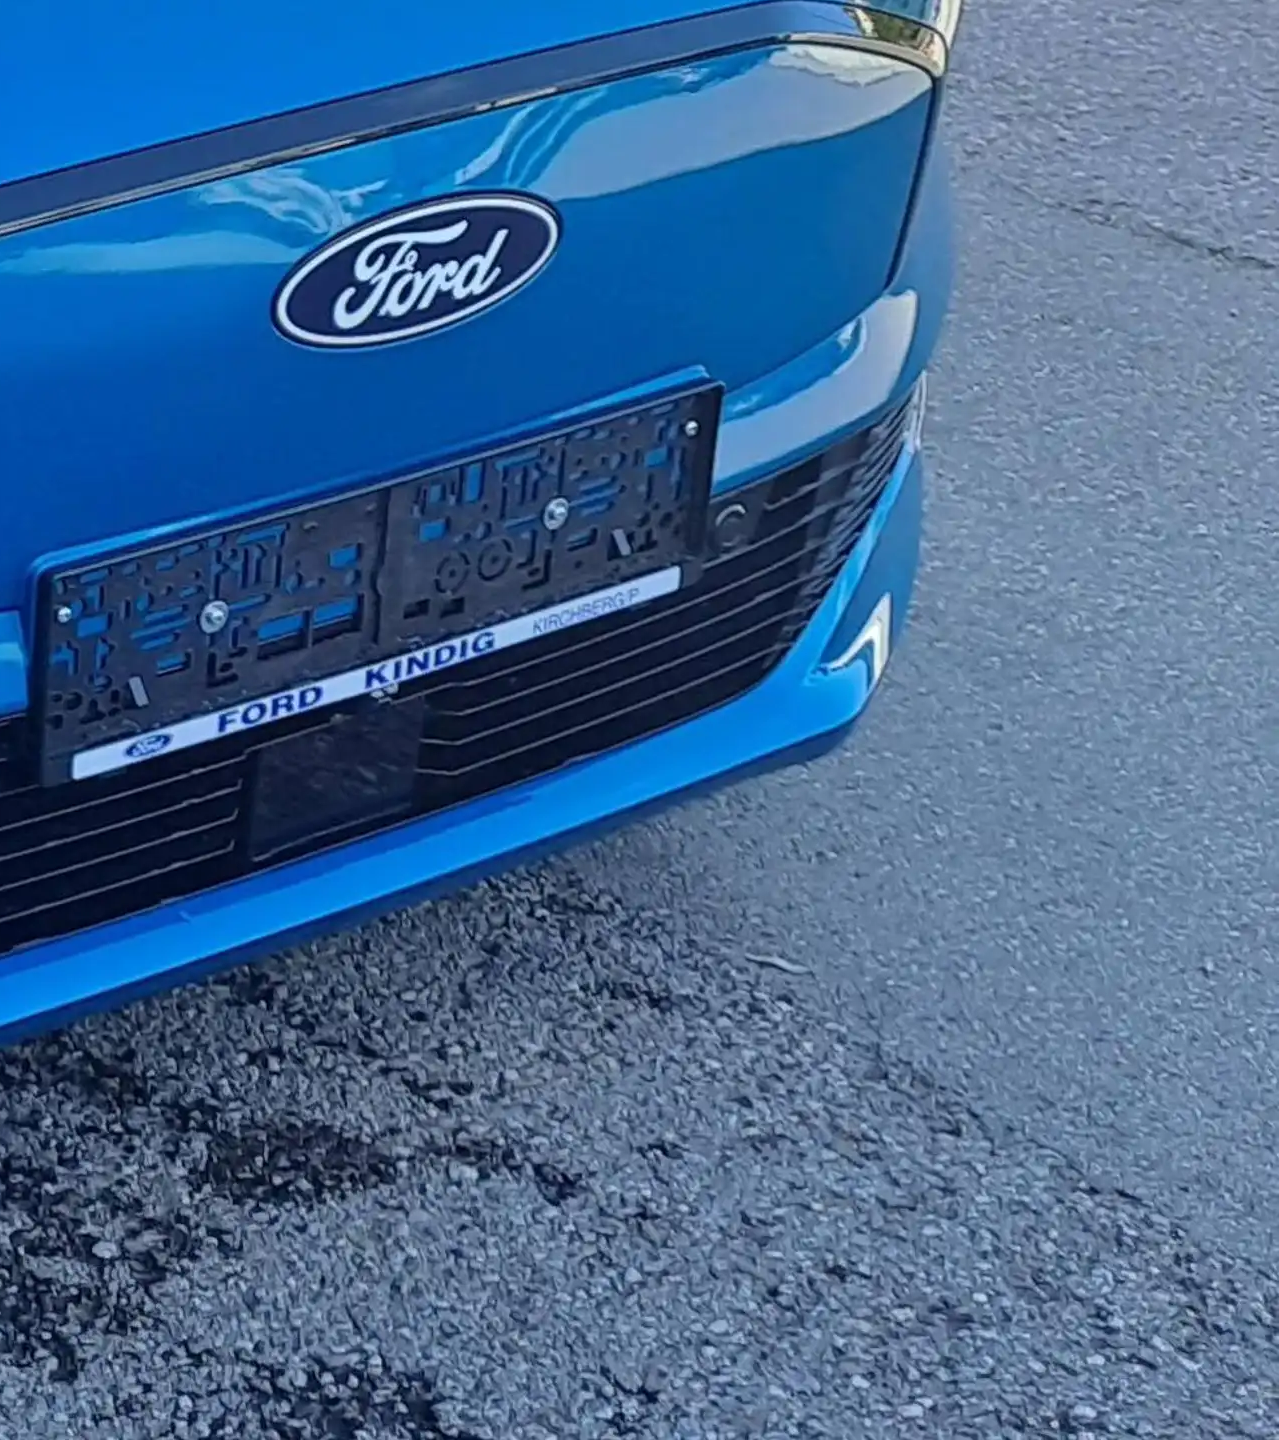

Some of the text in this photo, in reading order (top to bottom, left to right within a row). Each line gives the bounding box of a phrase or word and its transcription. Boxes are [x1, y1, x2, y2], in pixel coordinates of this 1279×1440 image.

[333, 219, 510, 330] Ford
[217, 684, 324, 733] FORD
[364, 631, 497, 689] KINDIG
